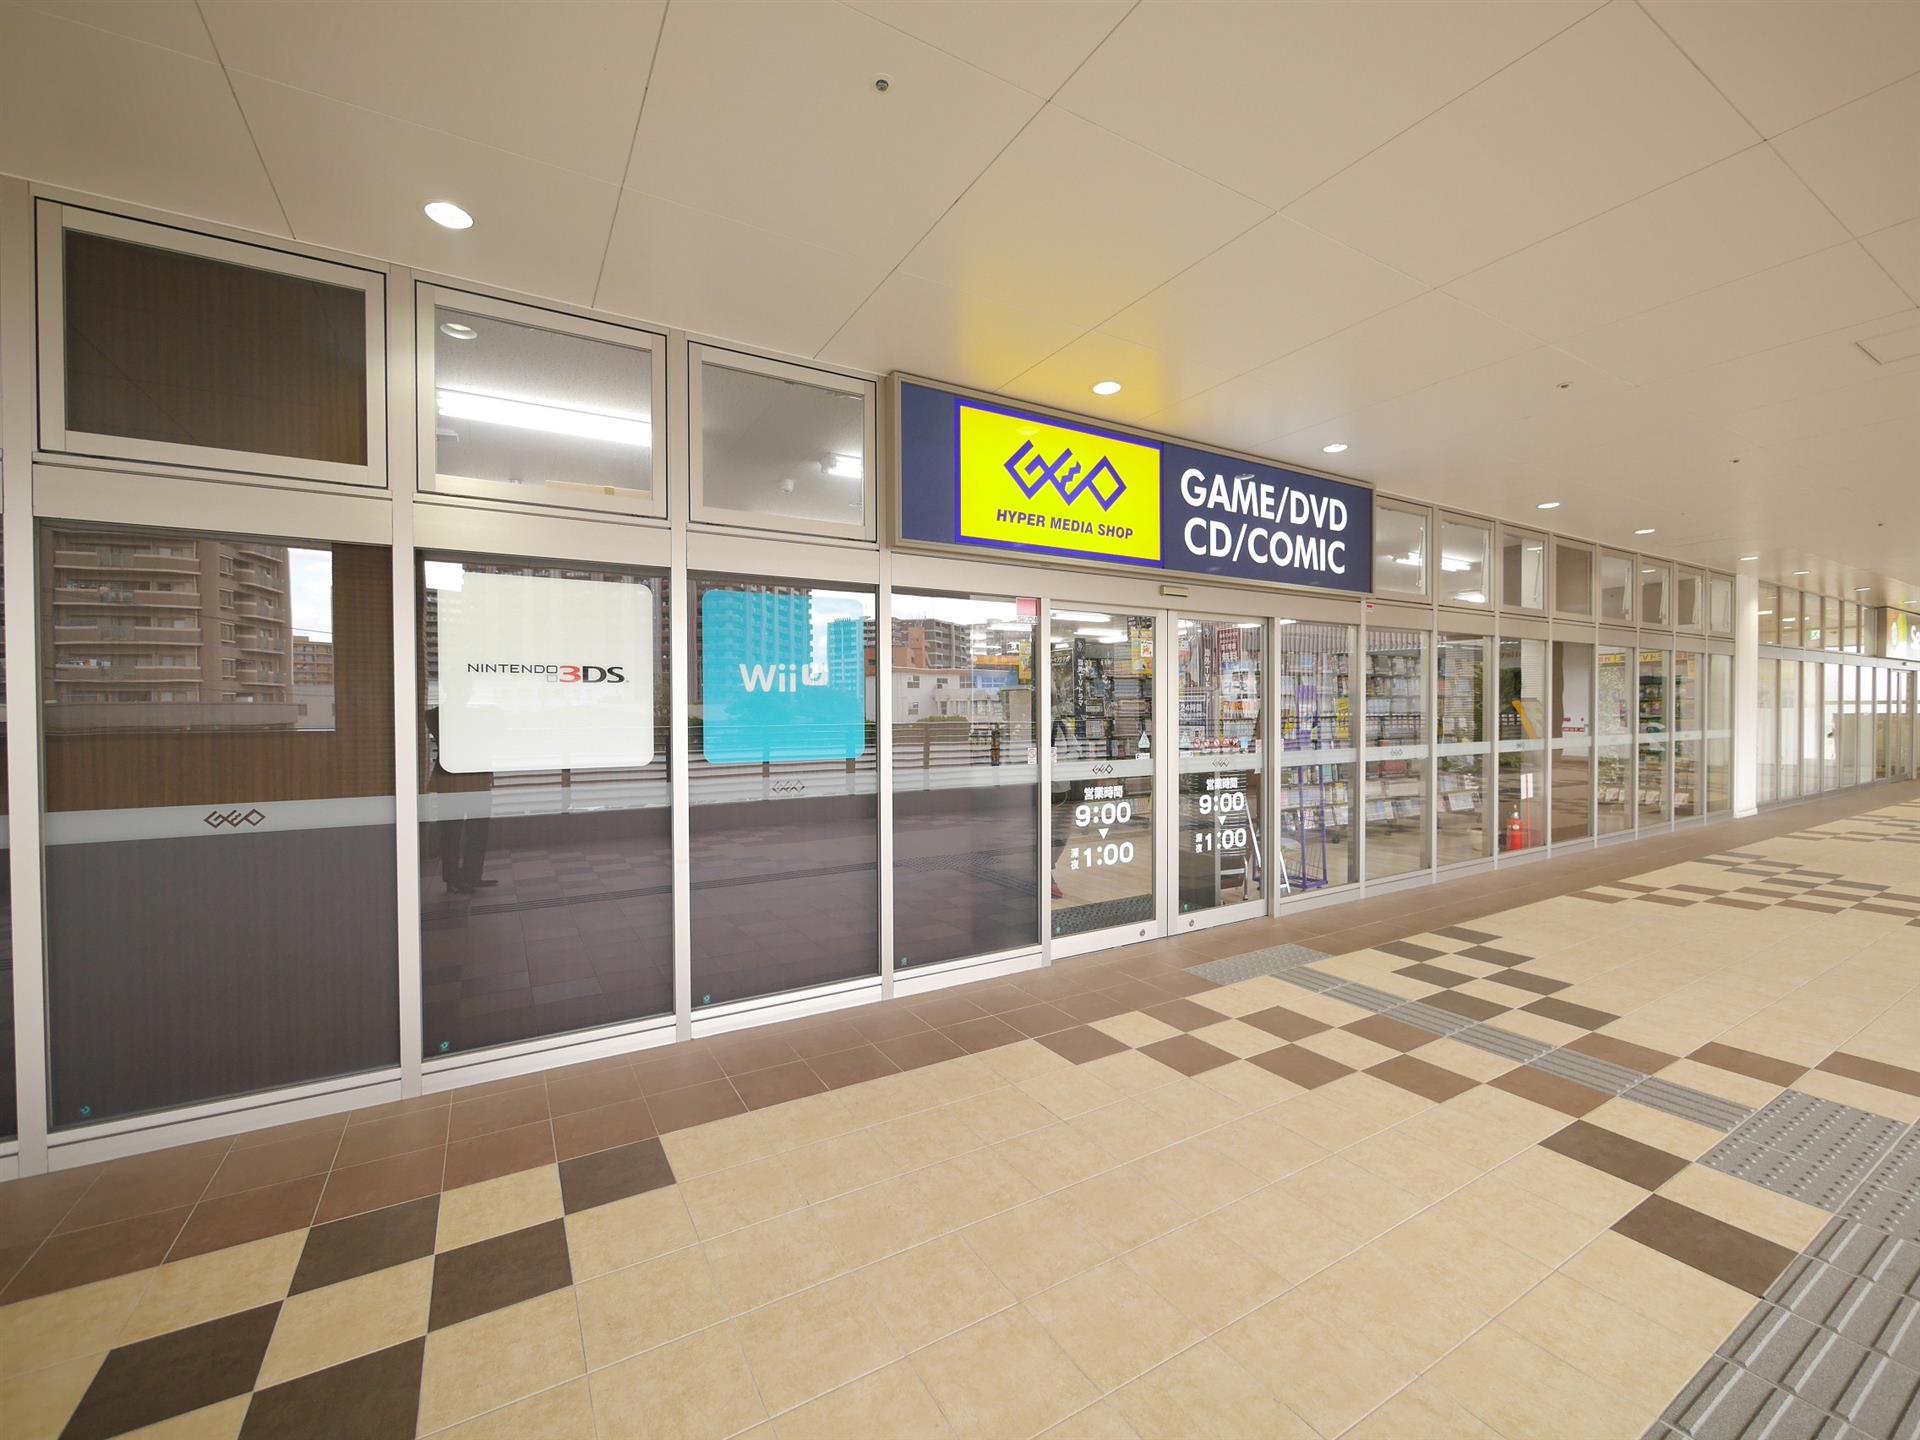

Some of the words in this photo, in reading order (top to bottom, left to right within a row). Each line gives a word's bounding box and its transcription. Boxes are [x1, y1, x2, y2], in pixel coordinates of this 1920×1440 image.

[1004, 439, 1127, 512] GEO
[1180, 468, 1348, 532] GAME/DVD
[996, 508, 1046, 528] HYPER
[1050, 516, 1094, 535] MEDIA
[1097, 523, 1134, 540] SHOP
[1184, 517, 1346, 574] CD/COMIC
[467, 663, 558, 674] NINTENDO
[559, 665, 625, 683] 3DS
[739, 663, 797, 692] Wii
[1083, 785, 1123, 800] 営業時間
[1206, 777, 1238, 791] 営業時間
[1075, 801, 1132, 827] 9:00
[1199, 791, 1245, 814] 9:00
[203, 808, 266, 829] GEO
[1205, 828, 1247, 850] 1:00
[1083, 841, 1134, 868] 1:00
